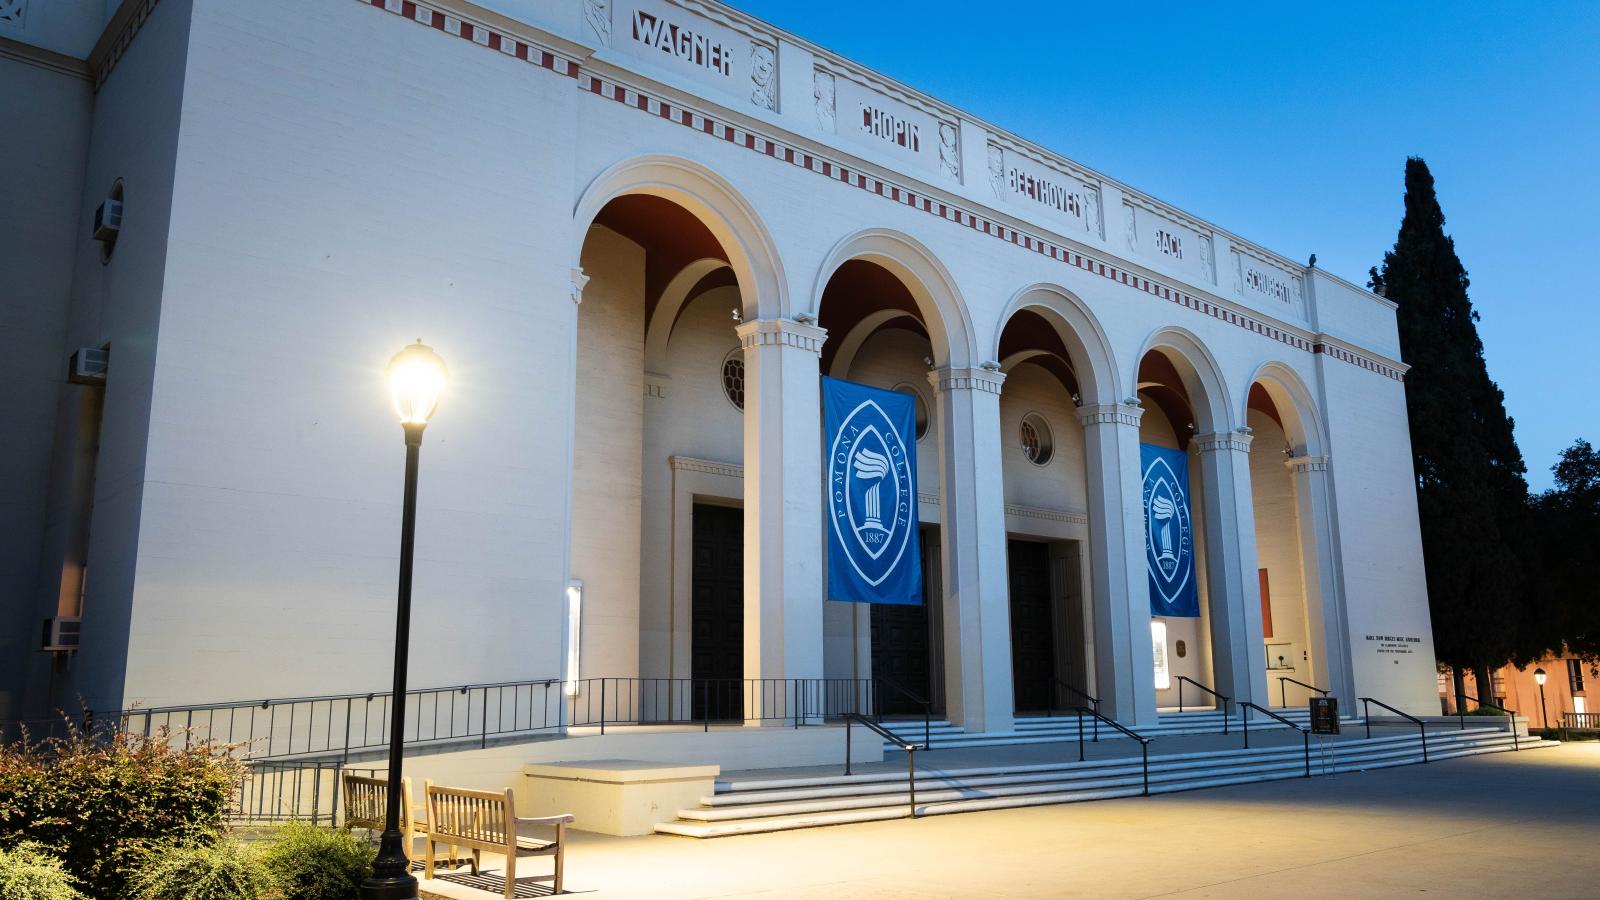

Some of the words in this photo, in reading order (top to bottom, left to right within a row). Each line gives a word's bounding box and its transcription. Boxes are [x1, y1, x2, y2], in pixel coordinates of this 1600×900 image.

[633, 9, 733, 76] WAGNER
[860, 102, 920, 152] CHOPIN
[1009, 168, 1080, 217] BEETHOVEN
[1155, 229, 1183, 259] BACH
[1246, 269, 1290, 304] SCHUBERT
[835, 425, 859, 518] POMONA
[885, 433, 908, 527] COLLEGE
[865, 532, 885, 544] 1887
